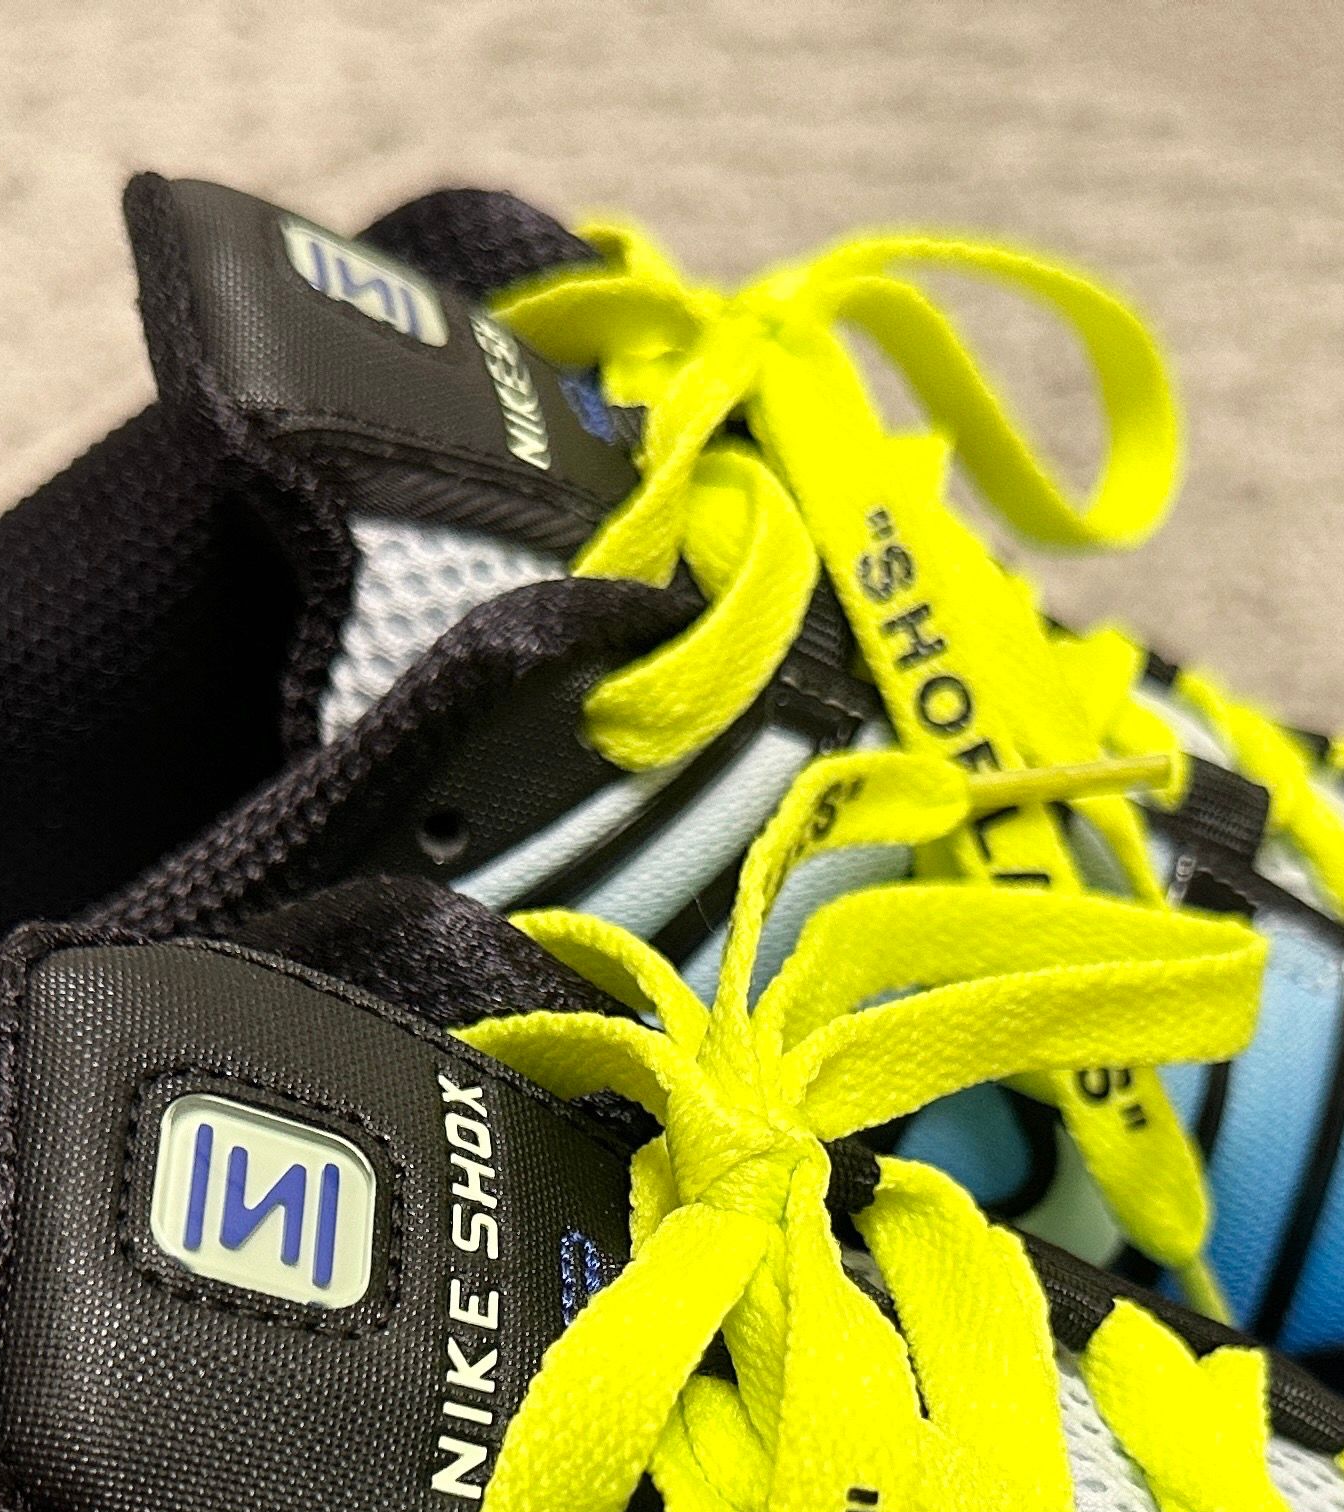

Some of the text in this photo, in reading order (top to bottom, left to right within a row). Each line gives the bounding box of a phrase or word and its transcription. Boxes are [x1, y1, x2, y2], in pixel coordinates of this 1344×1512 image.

[484, 351, 553, 471] NIKE
[430, 1074, 500, 1500] NIKE SHOX
